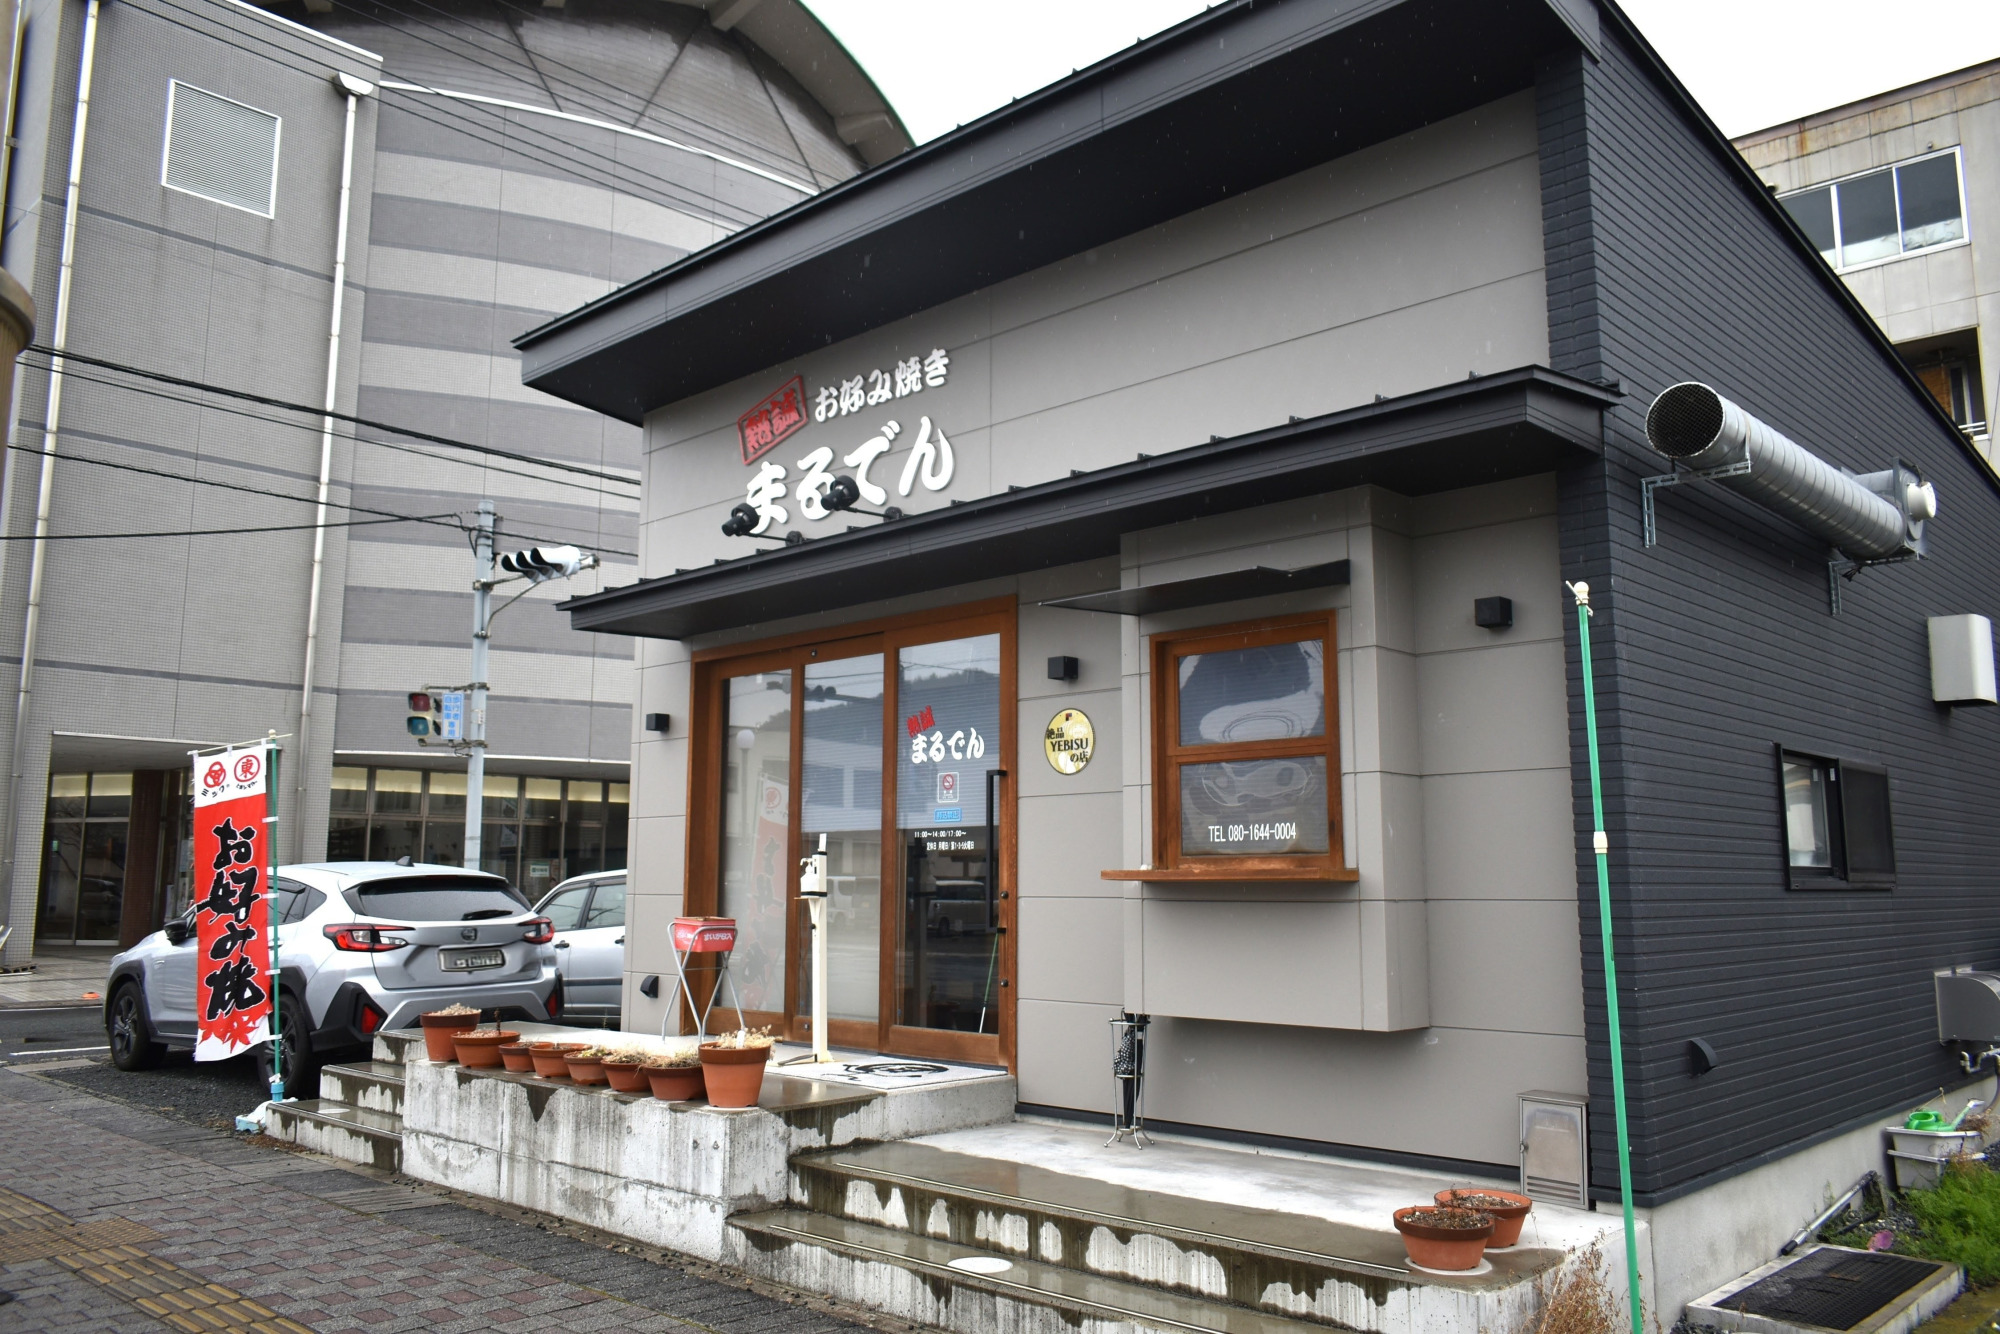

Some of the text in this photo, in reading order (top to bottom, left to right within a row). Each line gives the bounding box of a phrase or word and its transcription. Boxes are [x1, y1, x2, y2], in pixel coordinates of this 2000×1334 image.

[815, 348, 949, 422] お好み焼き
[746, 415, 954, 534] まるでん
[911, 727, 985, 764] まるでん
[1050, 737, 1089, 752] YEBISU
[1208, 822, 1297, 842] TEL 080-1644-0004
